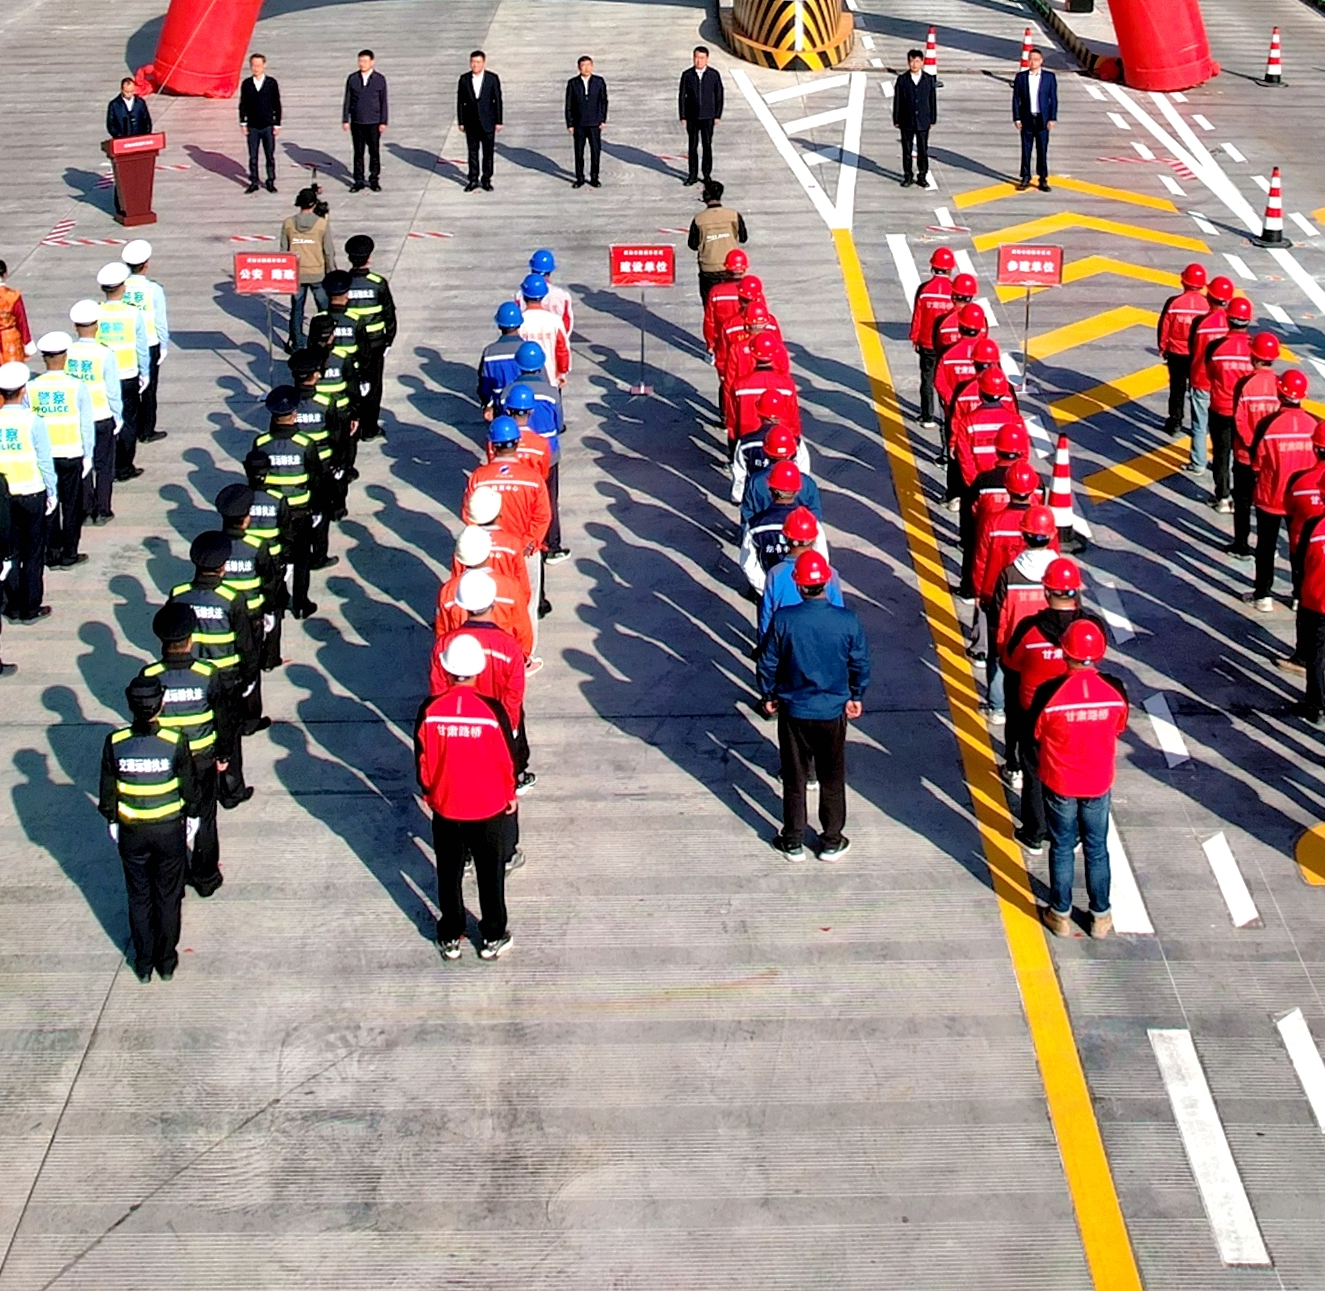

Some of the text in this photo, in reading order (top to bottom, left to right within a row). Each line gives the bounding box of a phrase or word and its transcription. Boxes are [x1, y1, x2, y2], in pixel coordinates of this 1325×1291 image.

[239, 268, 263, 280] 公安
[38, 391, 65, 405] 警察
[437, 724, 483, 738] 甘肃路桥
[119, 758, 172, 773] 交通运输执法
